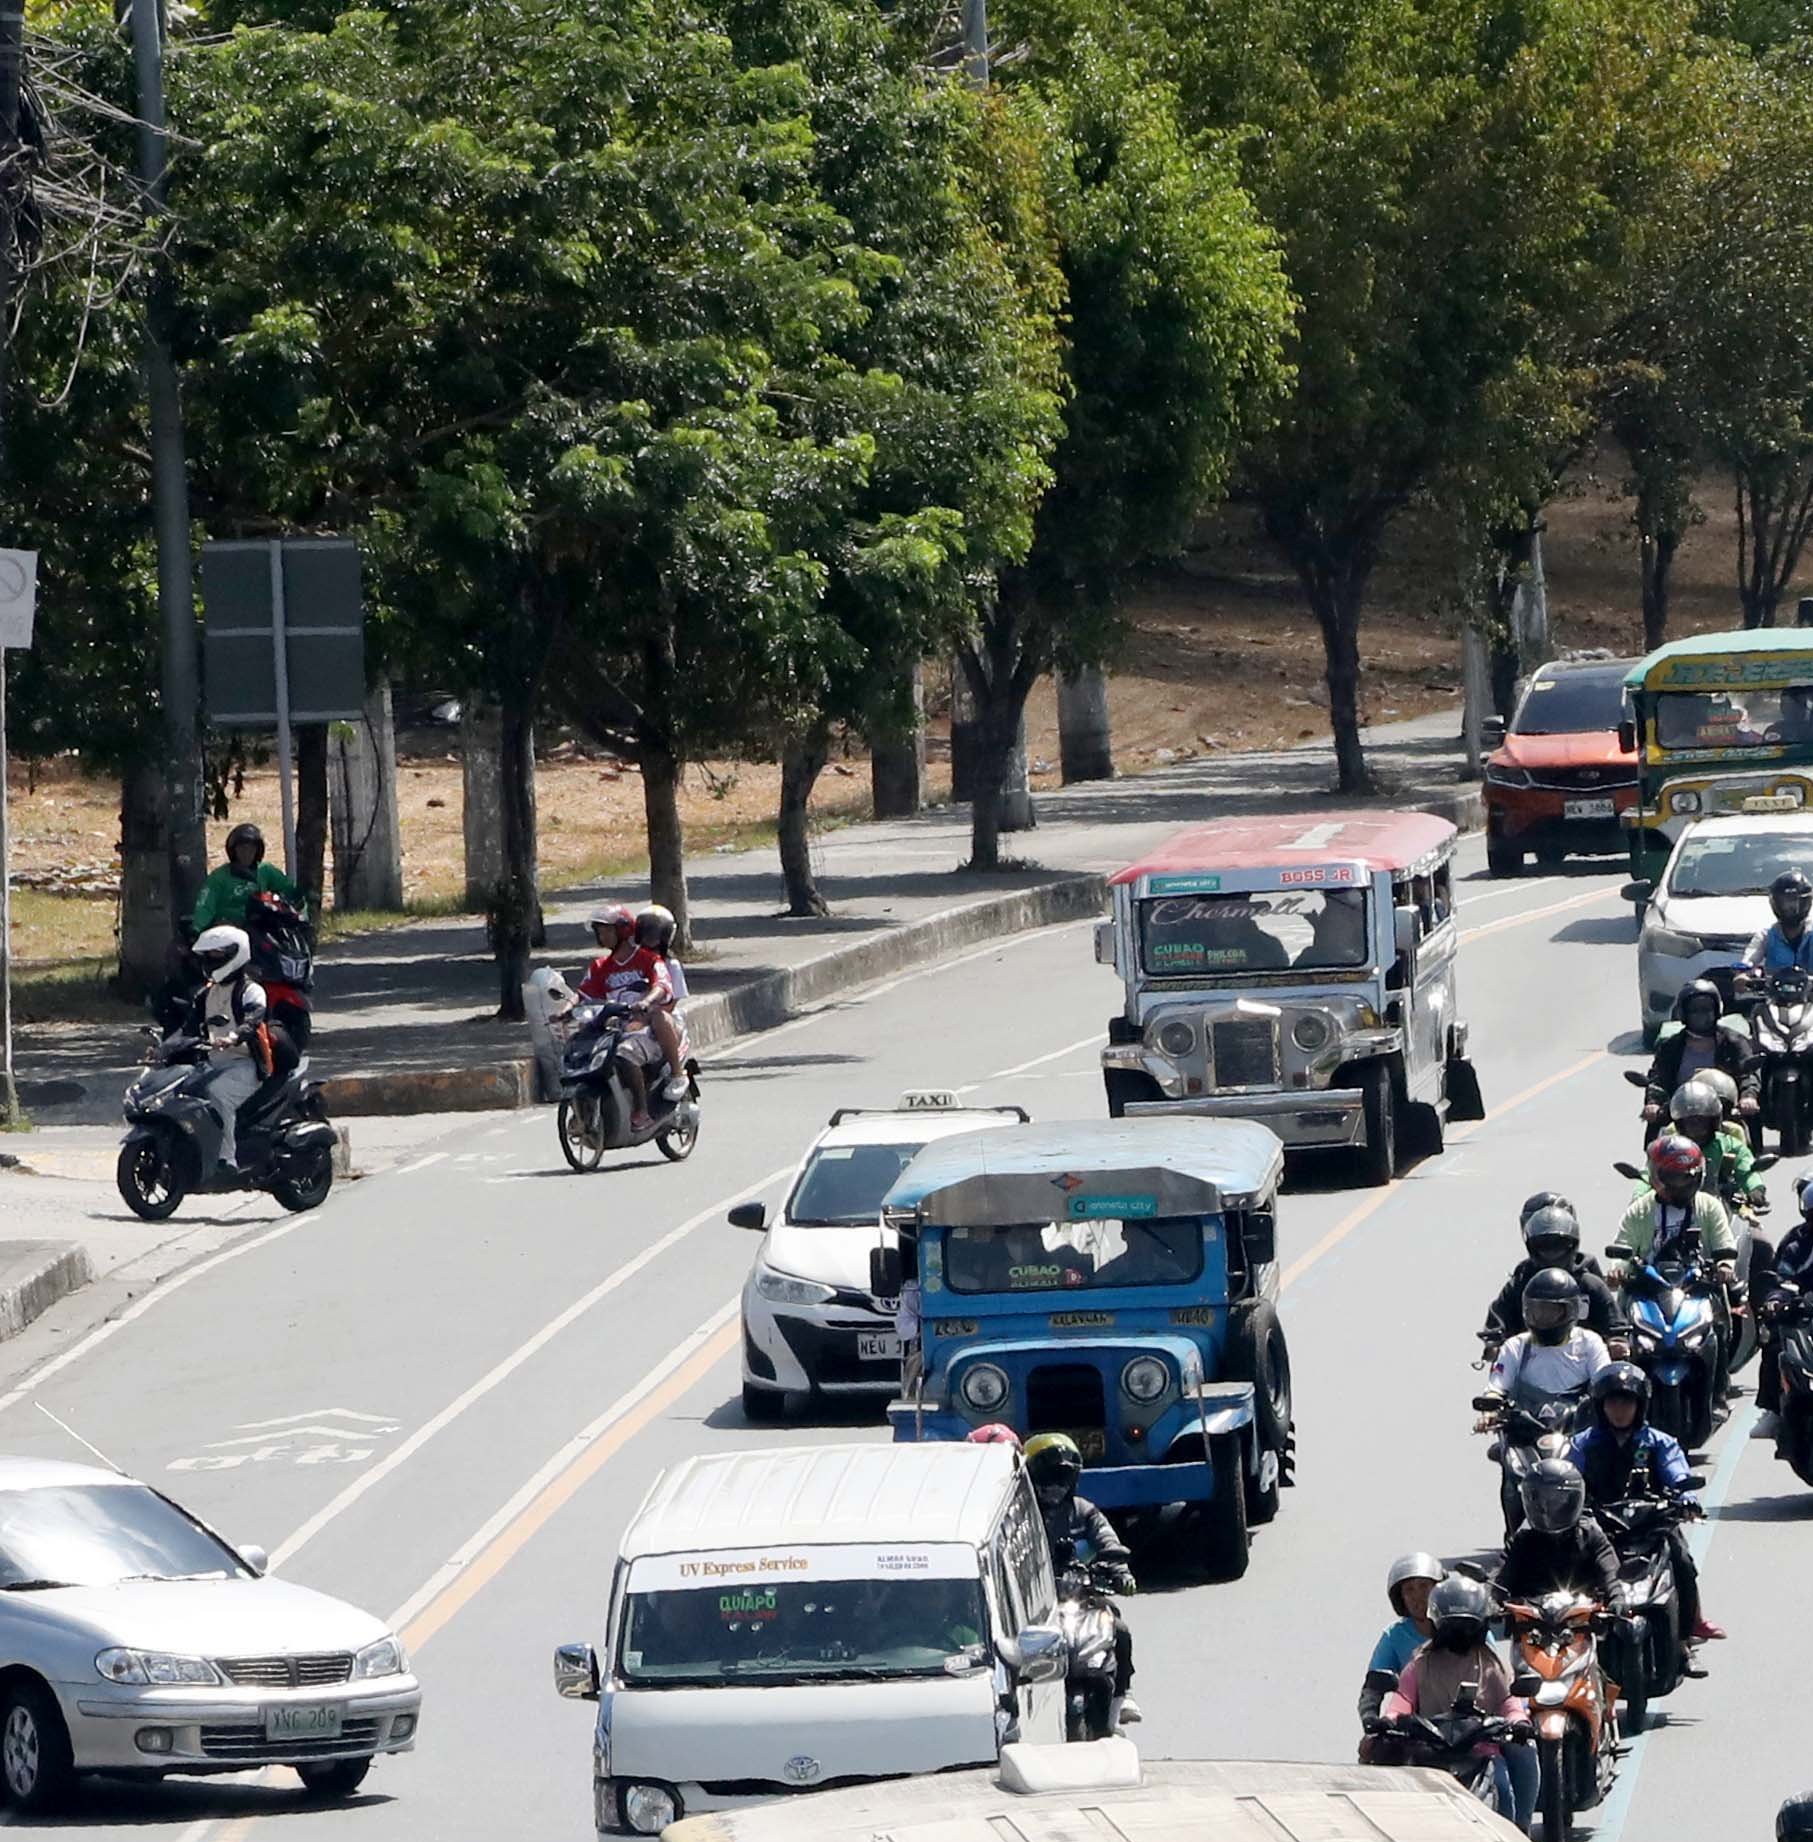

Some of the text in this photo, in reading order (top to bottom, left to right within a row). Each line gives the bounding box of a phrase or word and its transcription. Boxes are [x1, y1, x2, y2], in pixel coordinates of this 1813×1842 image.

[1280, 871, 1325, 884] BOSS
[906, 1094, 950, 1107] TAXI
[1008, 1264, 1061, 1279] CUBAO
[860, 1338, 887, 1355] NEU
[680, 1556, 809, 1577] UV Express Service
[719, 1595, 776, 1612] QUIAPO
